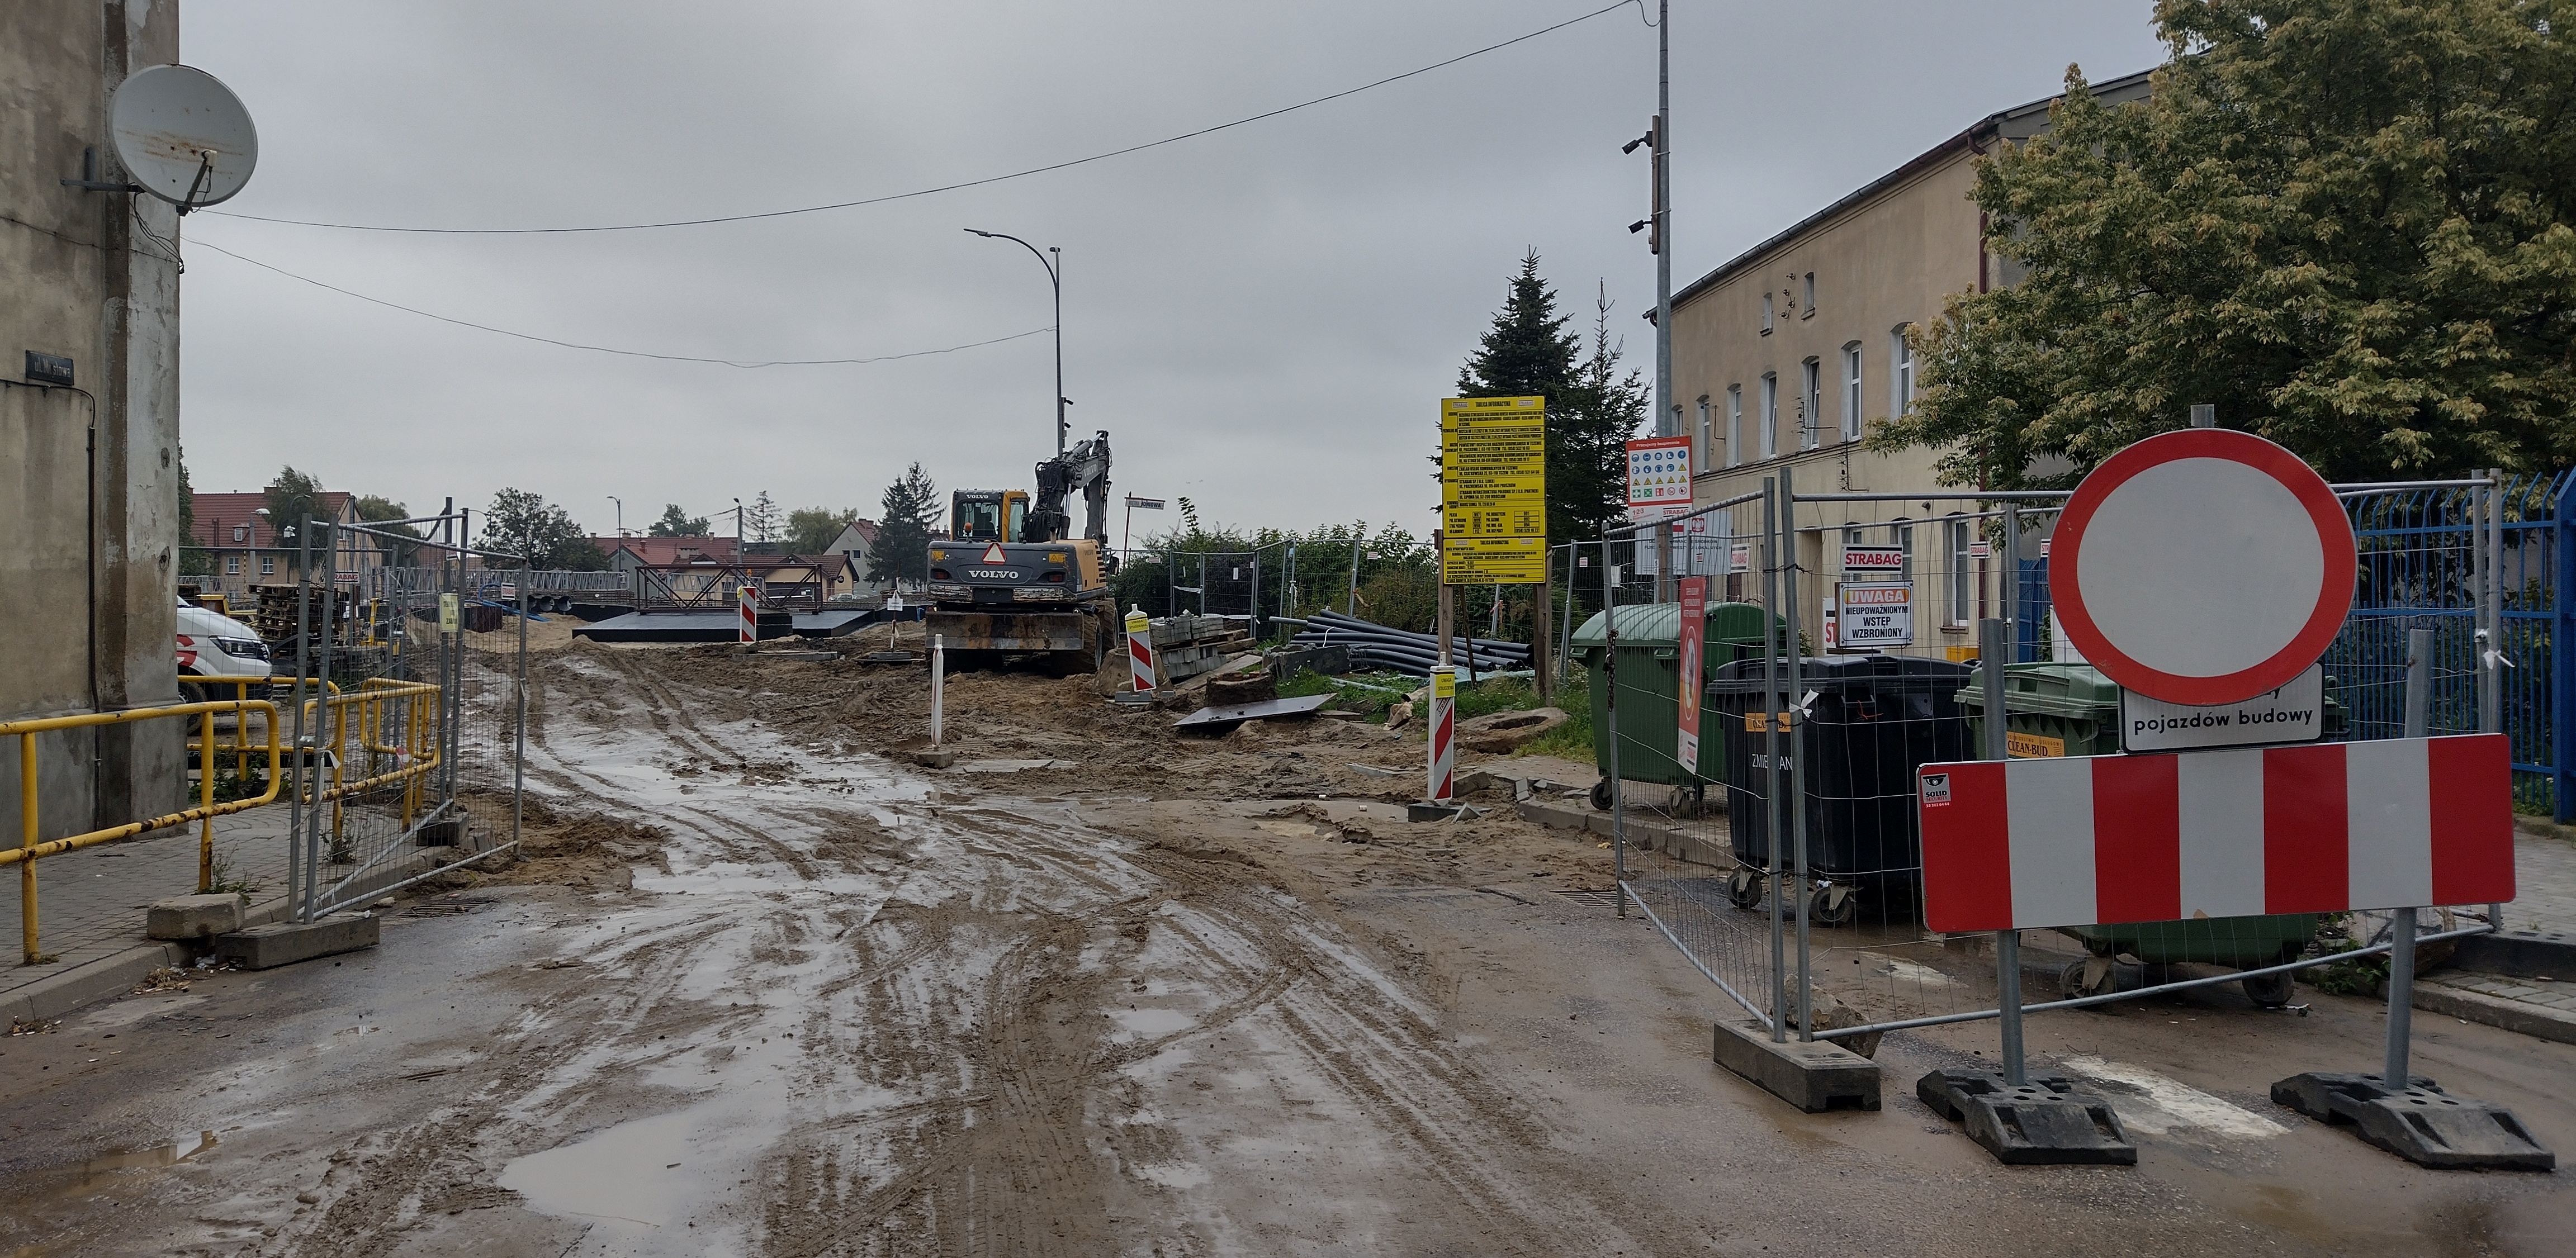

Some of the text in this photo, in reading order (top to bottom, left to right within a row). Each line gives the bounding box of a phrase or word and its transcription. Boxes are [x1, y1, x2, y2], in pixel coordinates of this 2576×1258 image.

[1083, 464, 1097, 477] VOLVO
[1731, 552, 1748, 564] STRABAG
[1845, 553, 1902, 566] STRABAG
[968, 570, 1019, 579] VOLVO
[1849, 590, 1905, 603] UWAGA
[1845, 605, 1908, 615] NIEUPOWAŻNIONYM
[1863, 616, 1891, 628] WSTĘP
[1852, 628, 1903, 639] WZBRONIONY
[2134, 708, 2313, 735] pojazdów budowy
[1752, 753, 1792, 771] ZMIEAN
